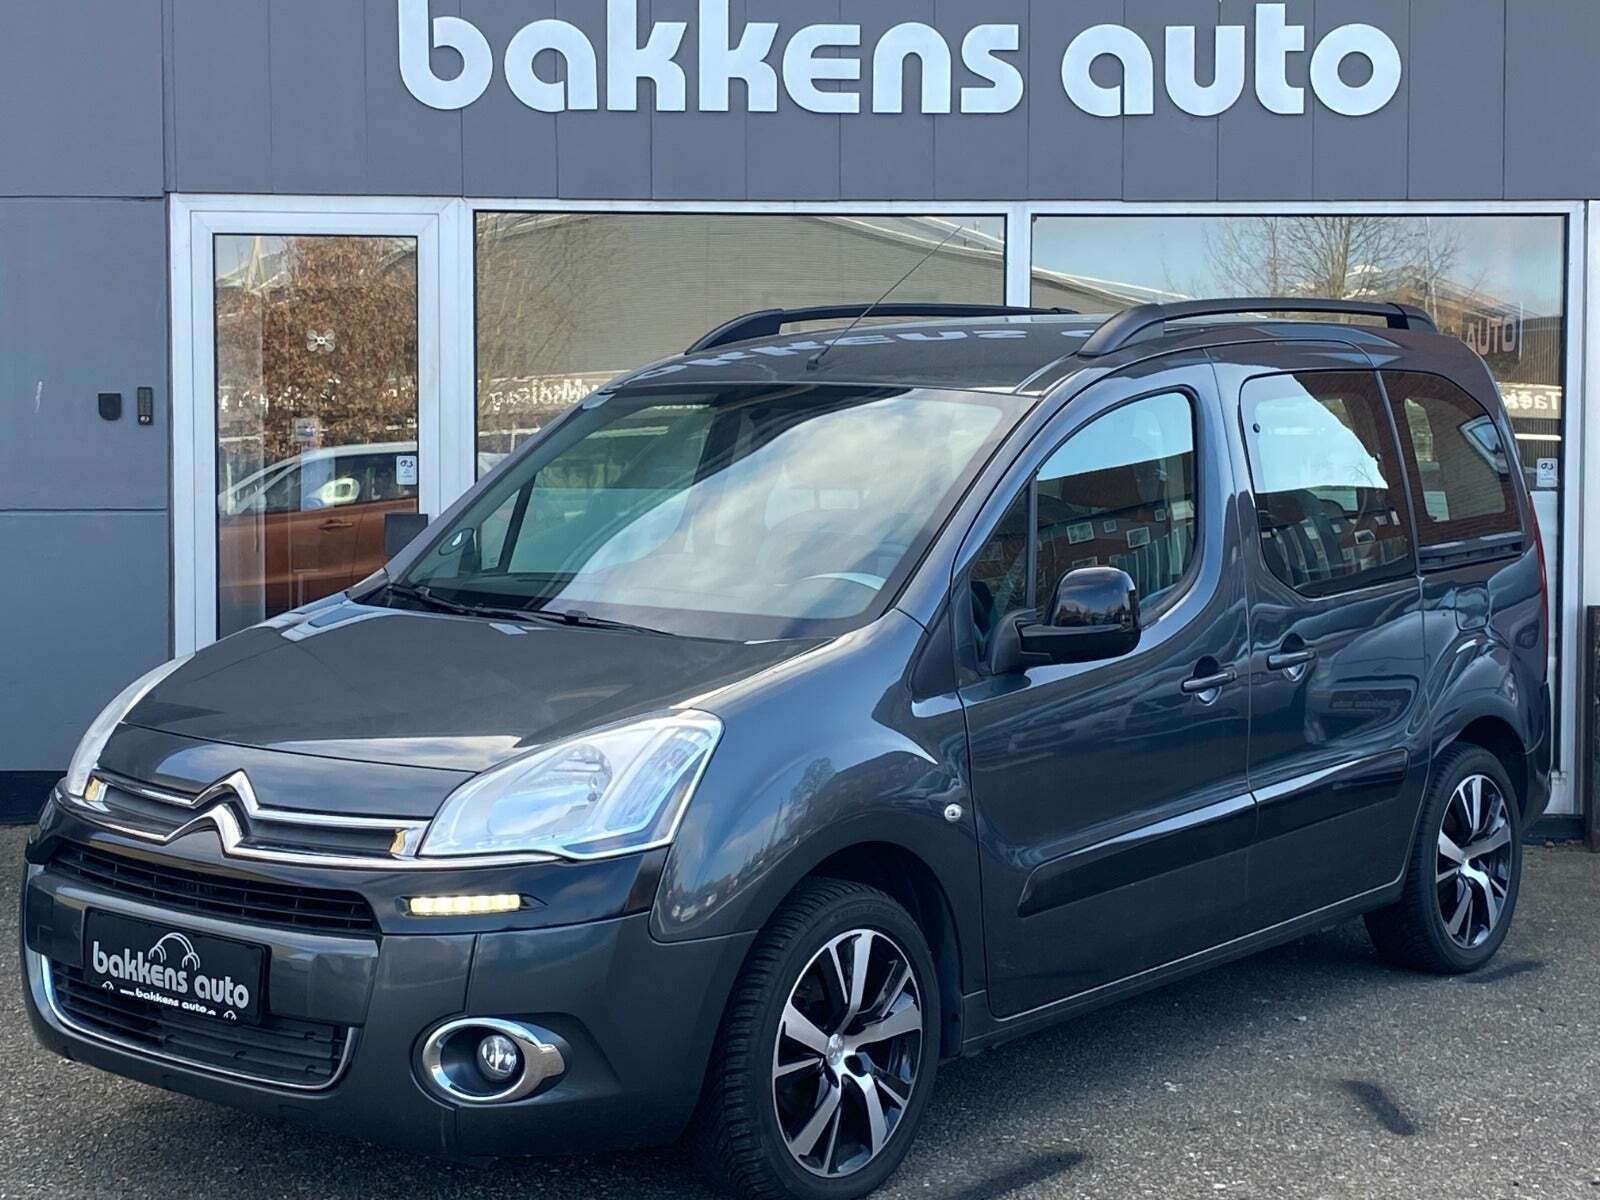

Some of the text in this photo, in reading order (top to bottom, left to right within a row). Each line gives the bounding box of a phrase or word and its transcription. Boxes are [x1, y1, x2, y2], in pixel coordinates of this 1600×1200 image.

[398, 0, 1402, 117] bakkens auto
[1466, 315, 1517, 355] AUTO
[93, 941, 249, 1008] bakkens auto
